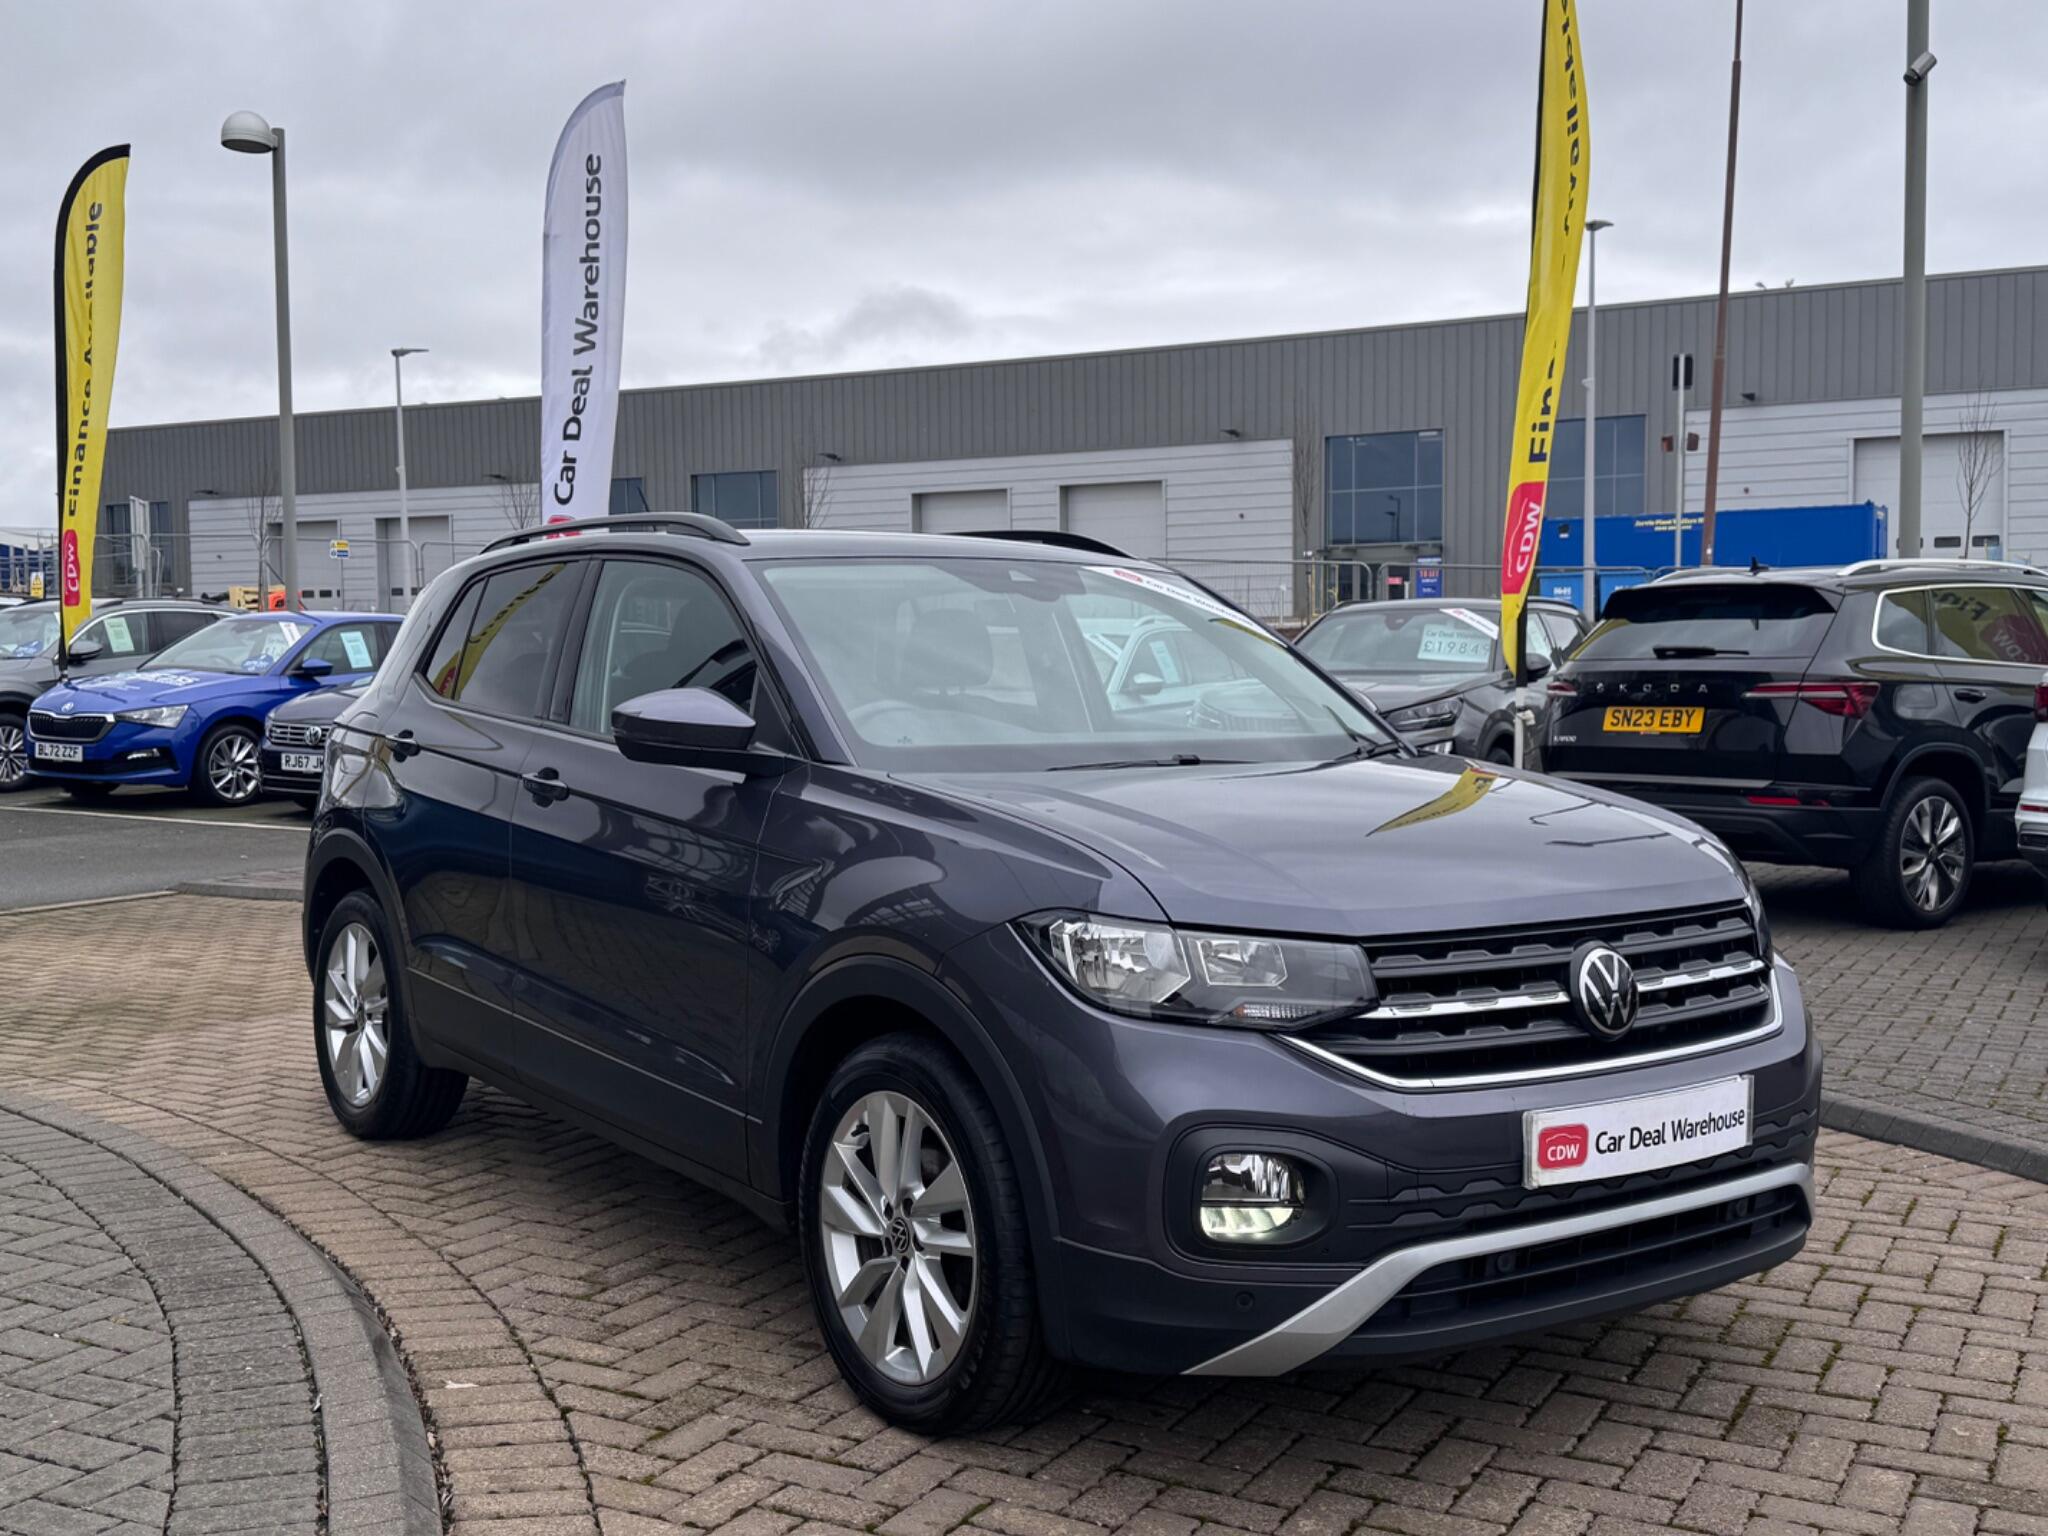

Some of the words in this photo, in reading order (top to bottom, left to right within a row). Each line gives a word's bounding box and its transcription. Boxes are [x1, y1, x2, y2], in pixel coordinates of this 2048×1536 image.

[573, 153, 602, 356] Warehouse
[562, 365, 593, 441] Deal
[554, 450, 578, 506] Car
[1516, 503, 1541, 573] CDW
[67, 543, 79, 592] CDW
[1610, 709, 1655, 727] SN23
[1659, 709, 1696, 728] EBY
[38, 743, 60, 757] BL72
[285, 755, 310, 768] RJ67
[1547, 1143, 1579, 1161] CDW
[1595, 1131, 1625, 1154] Car
[1629, 1122, 1666, 1150] Deal
[1671, 1108, 1745, 1141] Warehouse
